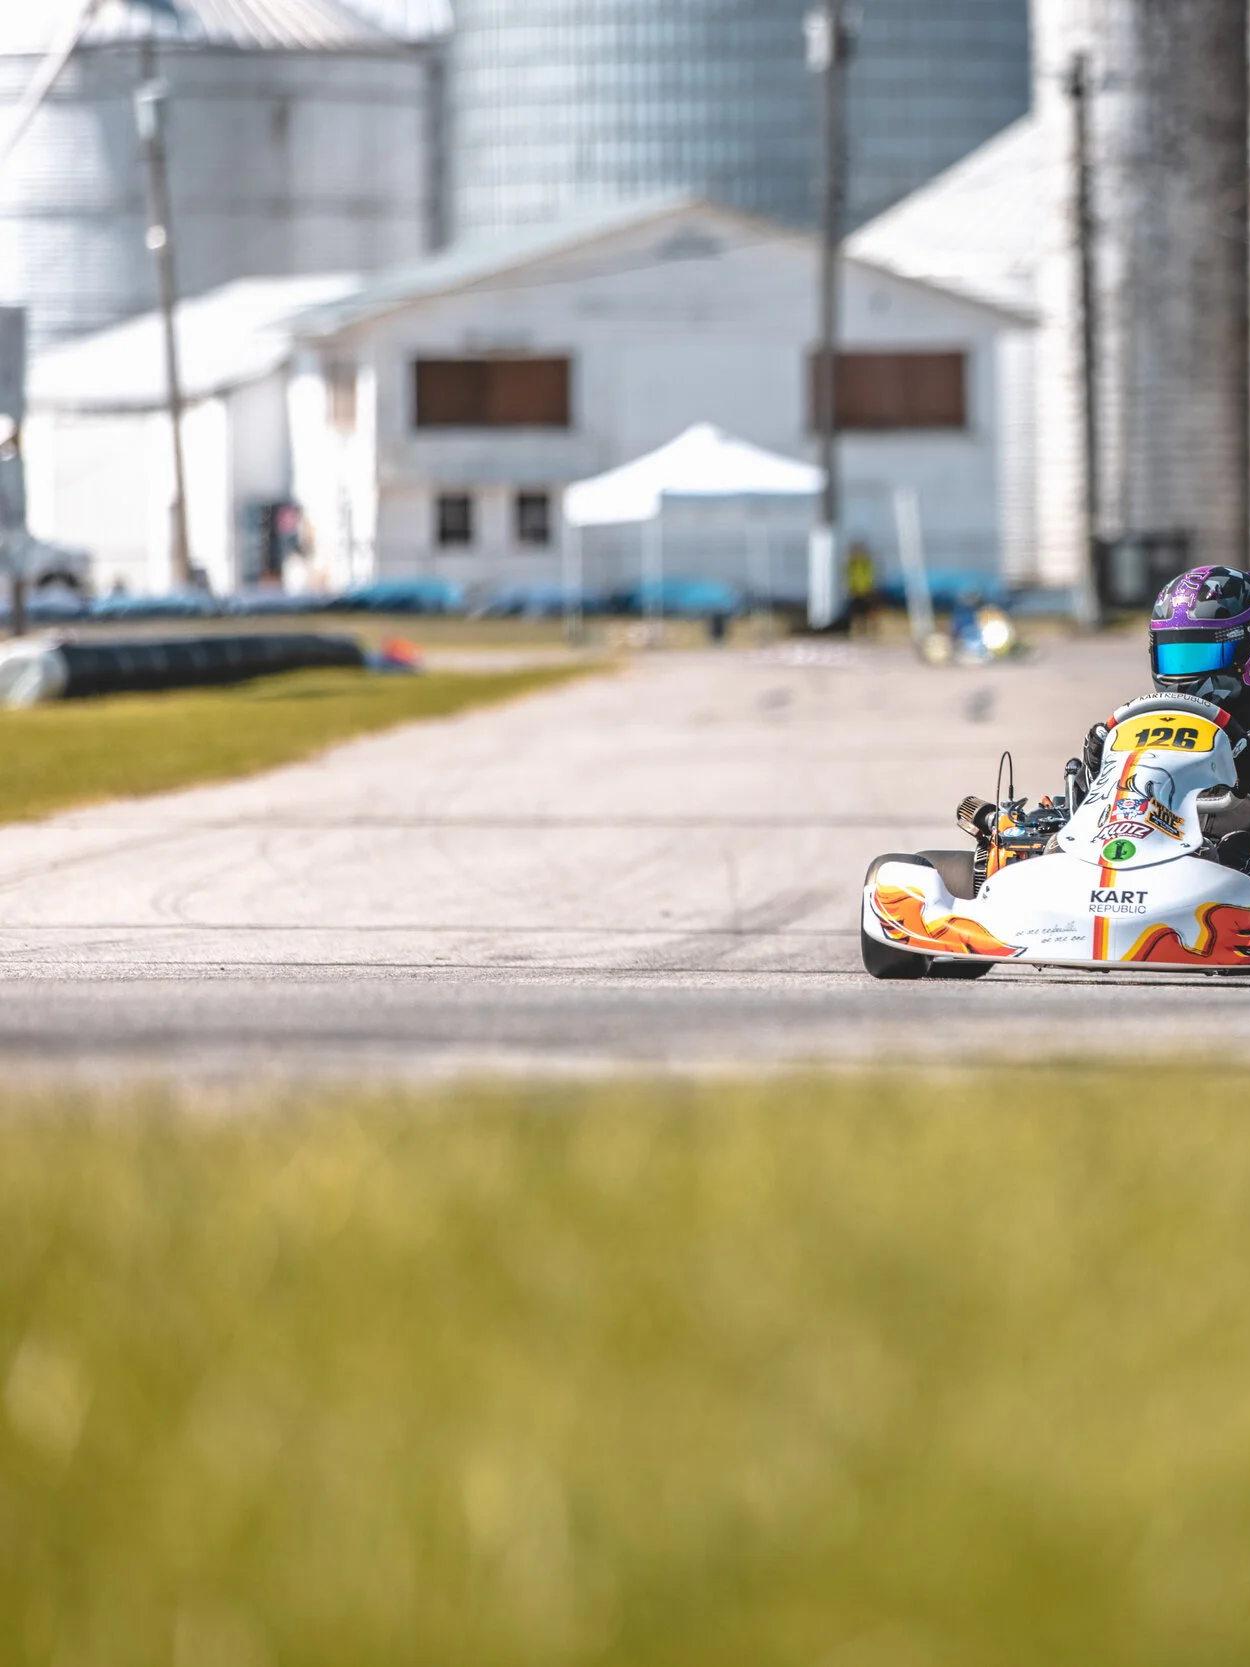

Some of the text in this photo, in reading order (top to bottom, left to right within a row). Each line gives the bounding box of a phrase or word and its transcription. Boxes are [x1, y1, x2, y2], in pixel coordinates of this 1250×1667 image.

[1135, 727, 1199, 749] 126
[1152, 807, 1180, 828] JOE
[1100, 822, 1149, 838] KLOTZ
[1090, 890, 1148, 904] KART
[1088, 904, 1147, 914] REPUBLIC
